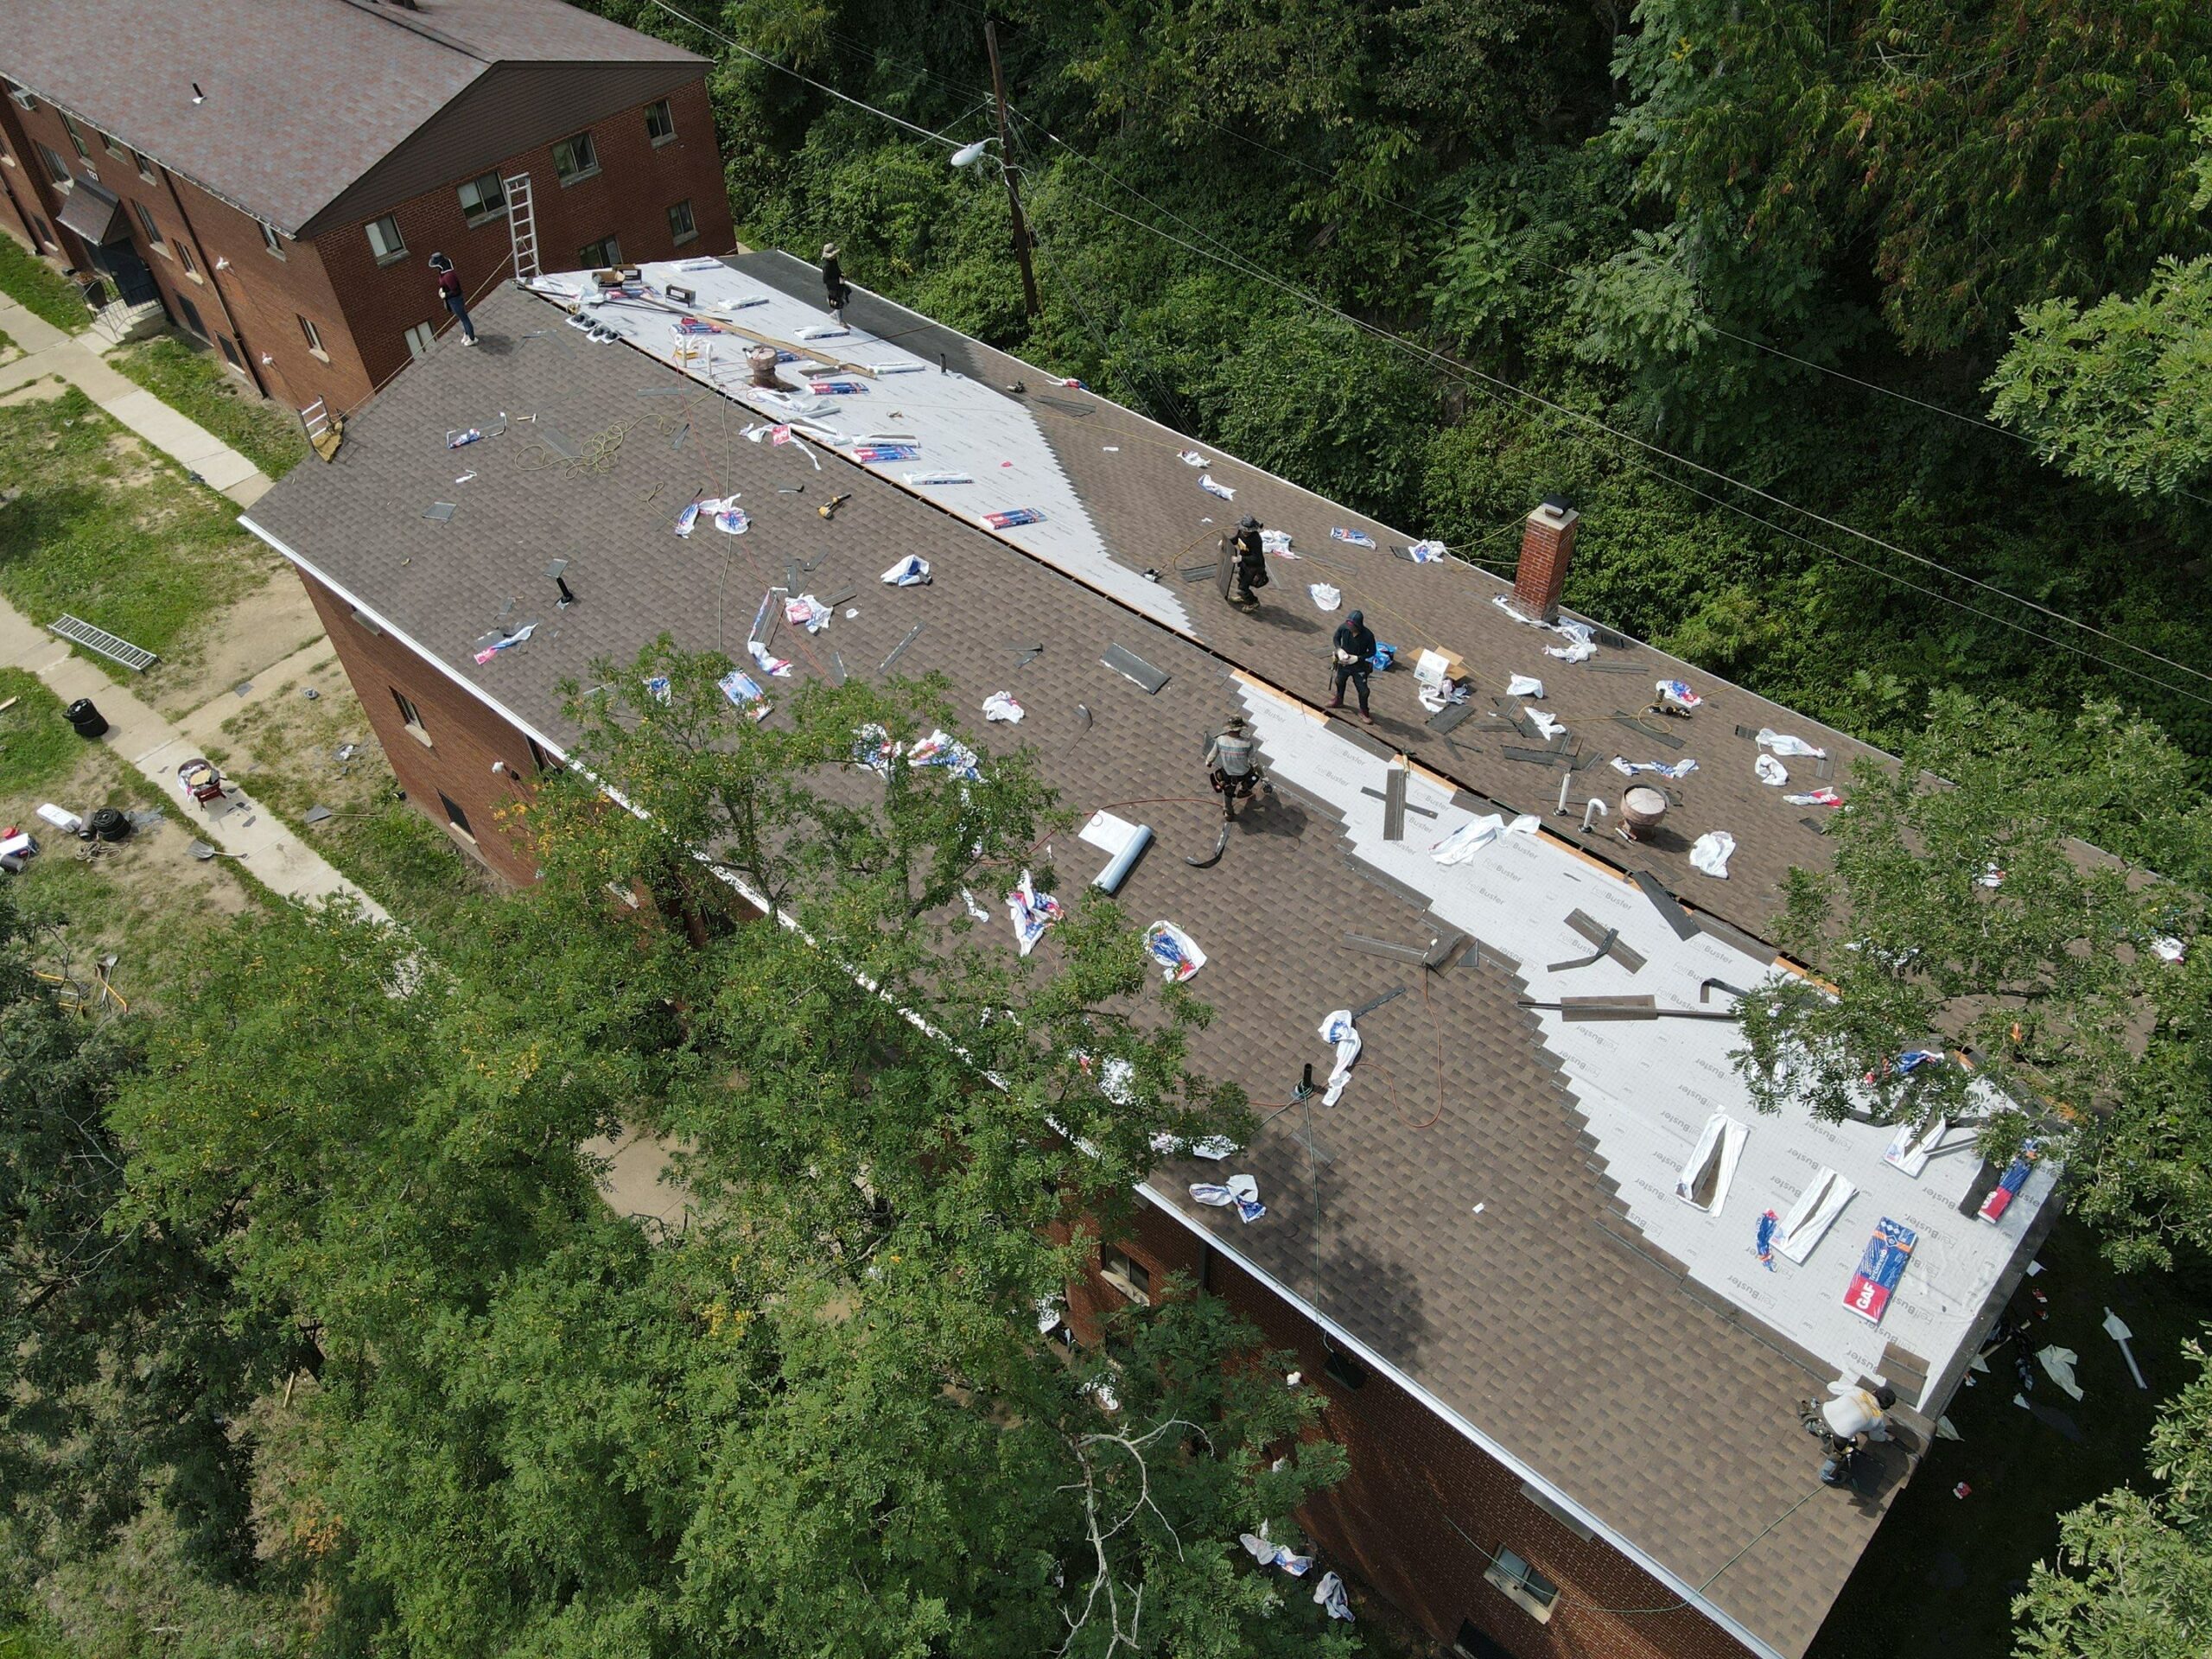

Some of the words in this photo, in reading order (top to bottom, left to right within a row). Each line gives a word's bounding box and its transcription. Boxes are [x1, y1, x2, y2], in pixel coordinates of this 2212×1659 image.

[1408, 817, 1433, 835] Buster
[1391, 838, 1417, 856] Buster
[1558, 931, 1596, 957] FeltBuste
[1672, 961, 1707, 983] FeltBus
[1652, 1150, 1683, 1174] Buster
[1787, 1147, 1820, 1170] Buster
[1770, 1175, 1803, 1198] Buster
[1922, 1185, 1957, 1211] Buster
[1628, 1211, 1663, 1238] FeltBus
[1728, 1274, 1777, 1310] FeltBuster
[1856, 1281, 1878, 1309] GAF
[1891, 1294, 1936, 1326] FeltBust
